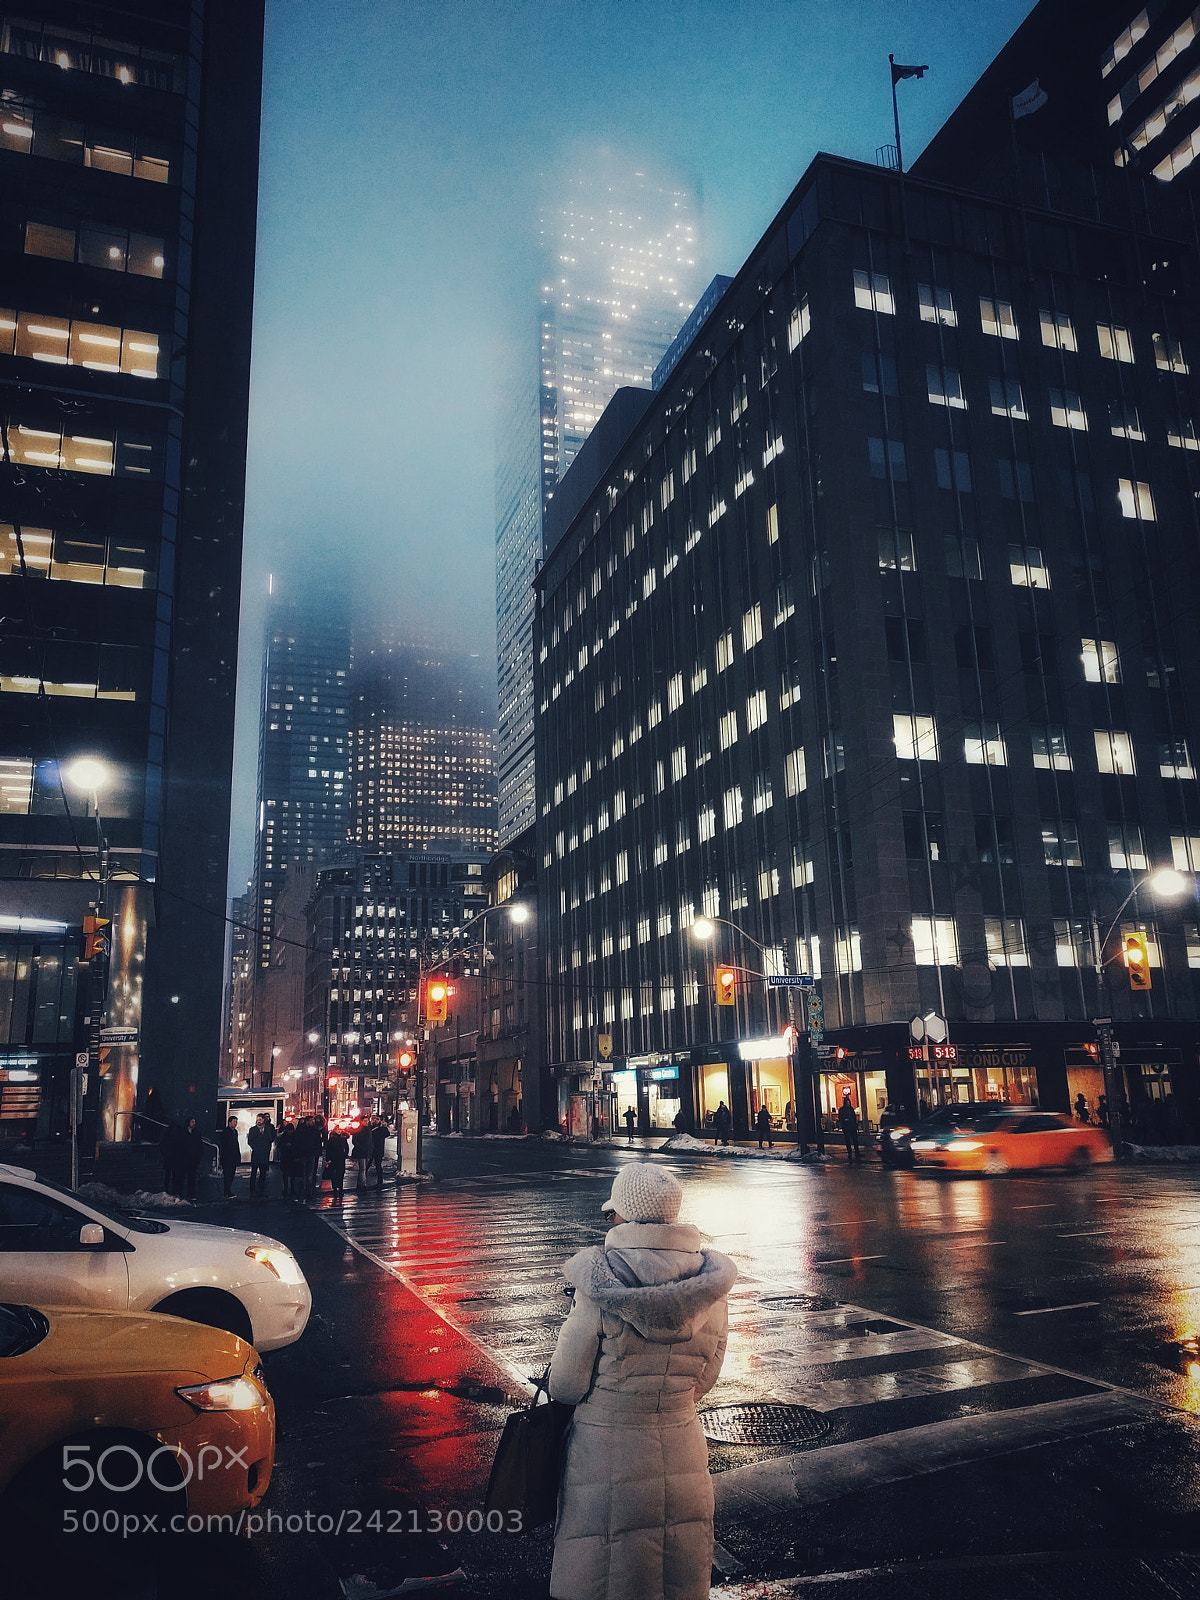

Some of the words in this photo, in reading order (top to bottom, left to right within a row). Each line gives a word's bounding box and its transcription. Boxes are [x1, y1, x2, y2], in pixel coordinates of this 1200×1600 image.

[770, 976, 804, 985] University
[935, 1047, 956, 1059] 5:13
[1002, 1052, 1027, 1066] CUP
